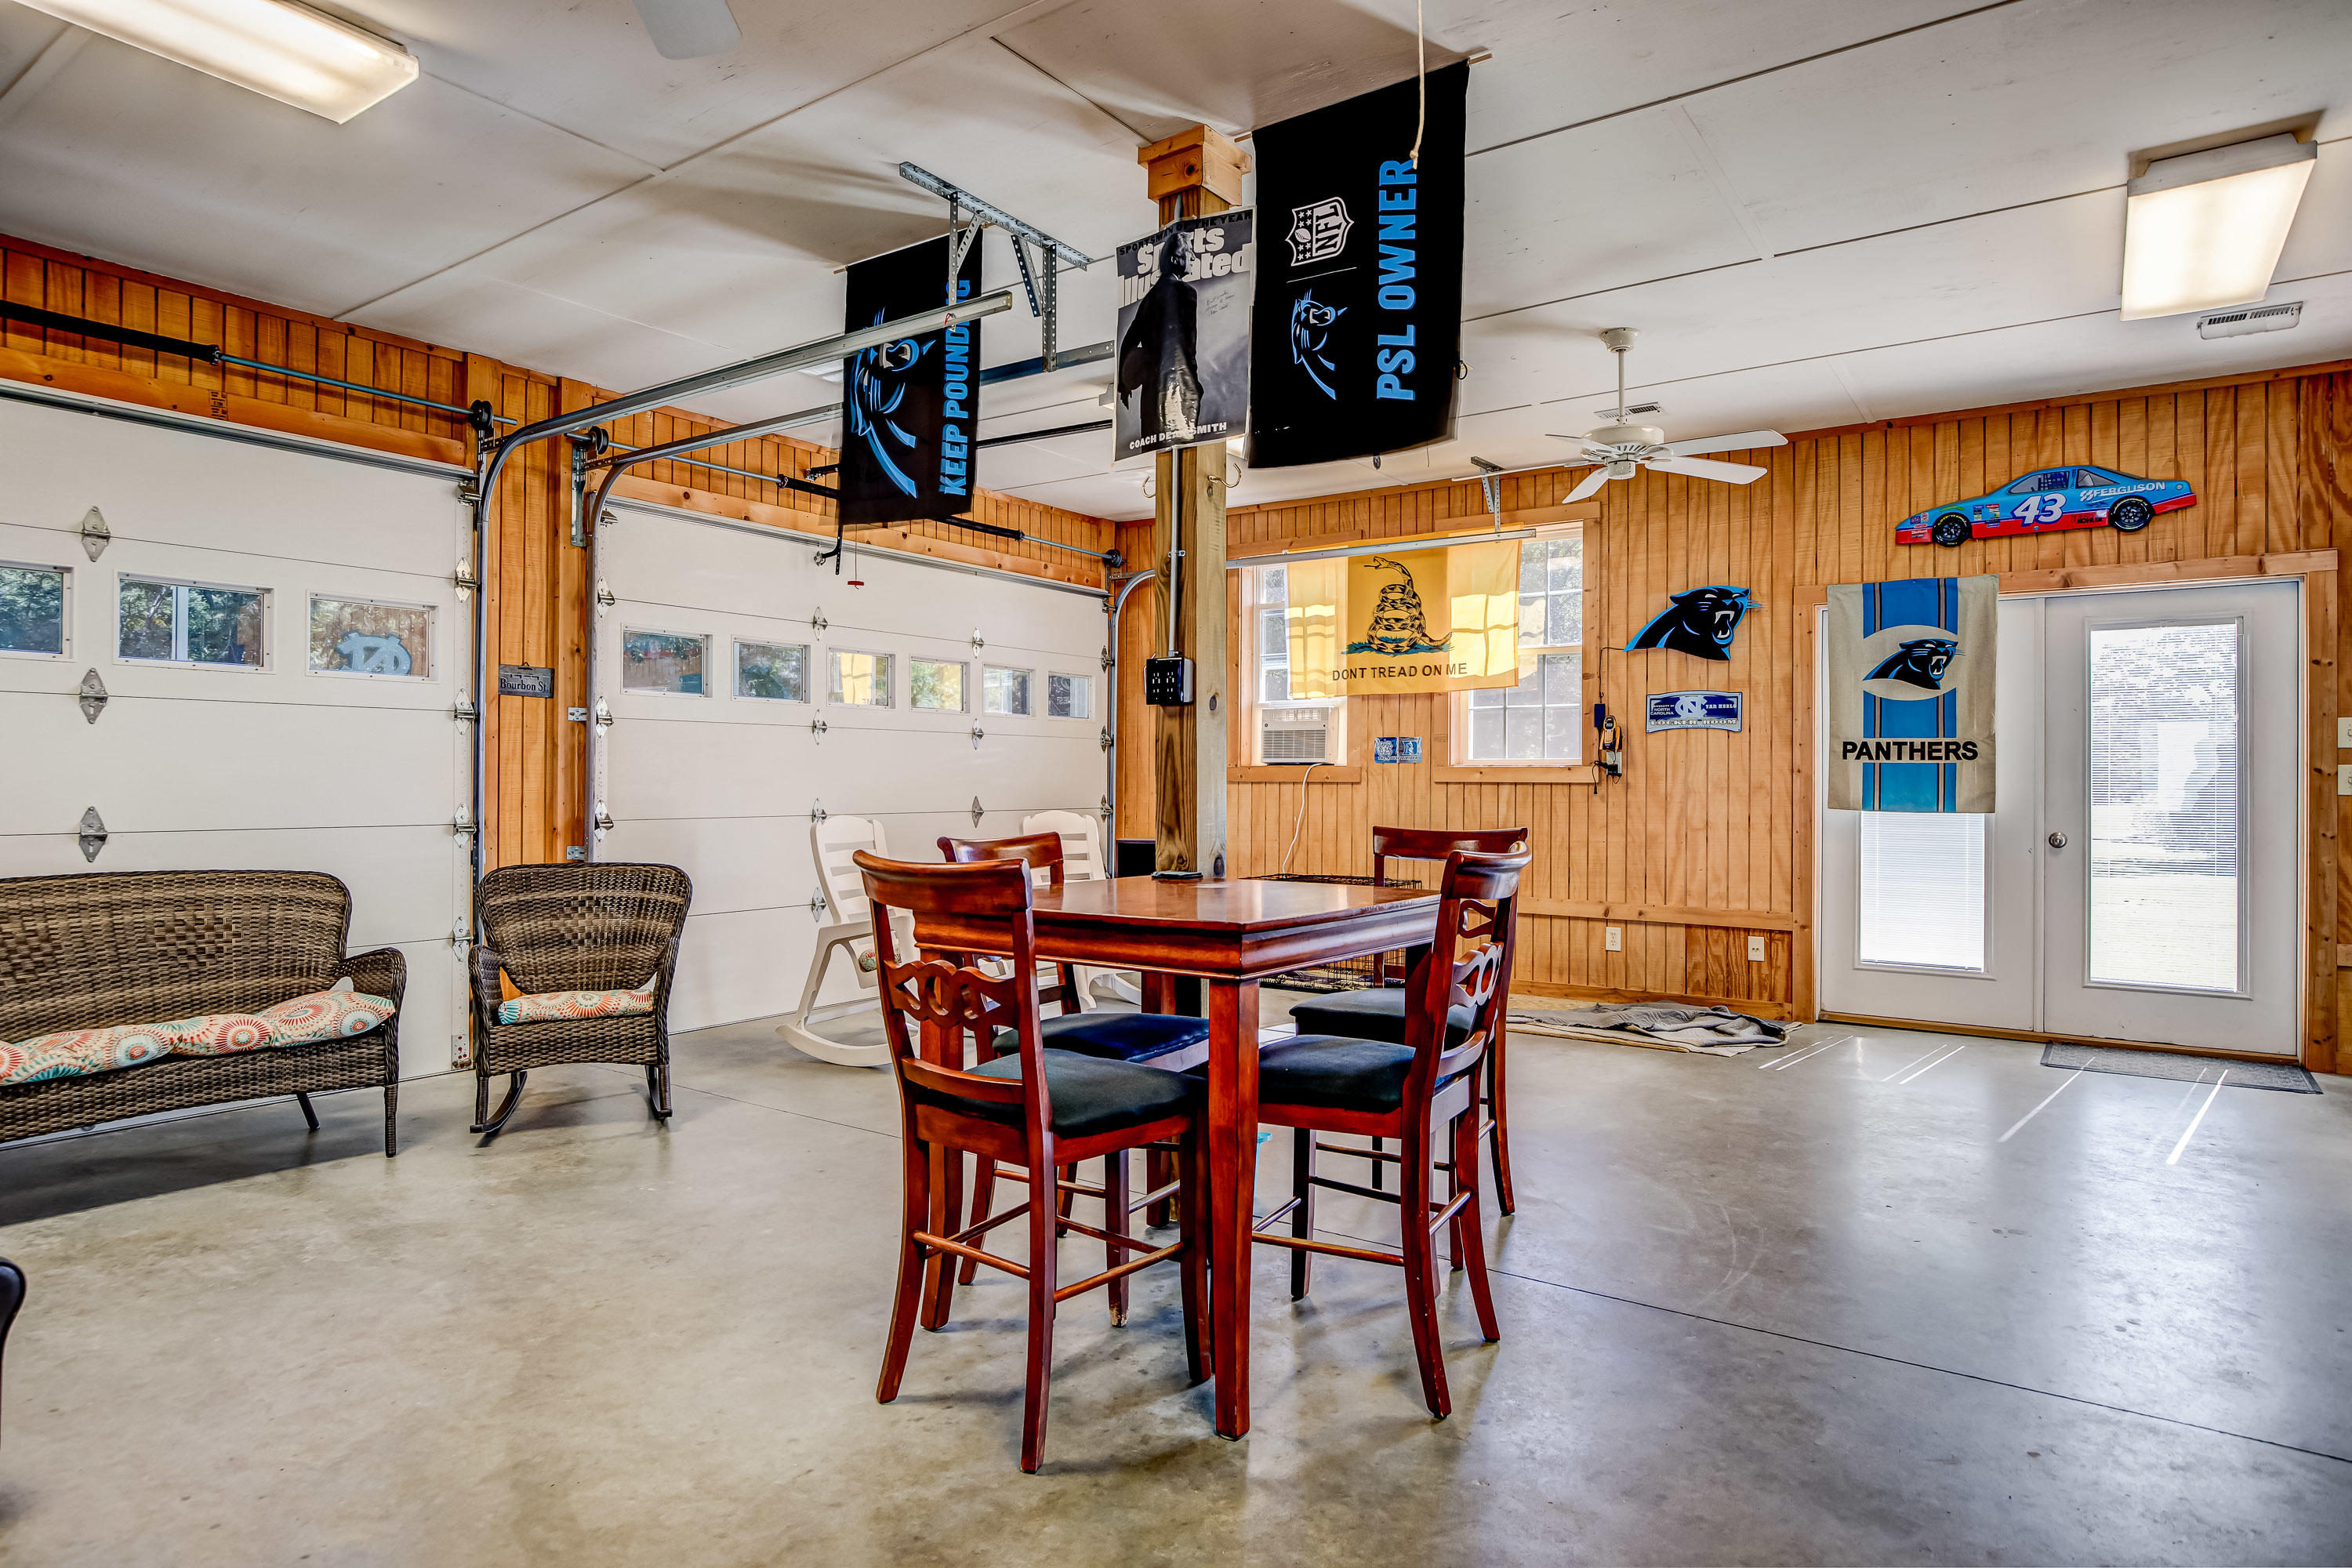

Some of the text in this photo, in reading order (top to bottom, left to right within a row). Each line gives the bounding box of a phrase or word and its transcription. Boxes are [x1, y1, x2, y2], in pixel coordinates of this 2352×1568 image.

[1220, 212, 1253, 224] YEAR
[1315, 204, 1343, 254] NFL
[1377, 159, 1417, 401] PSL OWNER
[1129, 434, 1157, 450] COACH
[939, 423, 968, 496] KEEP
[2092, 481, 2165, 497] FERGUSON
[2013, 492, 2067, 525] 43
[1332, 662, 1468, 681] DONT TREAD ON ME
[499, 678, 536, 691] Bourbon
[1842, 740, 1979, 761] PANTHERS
